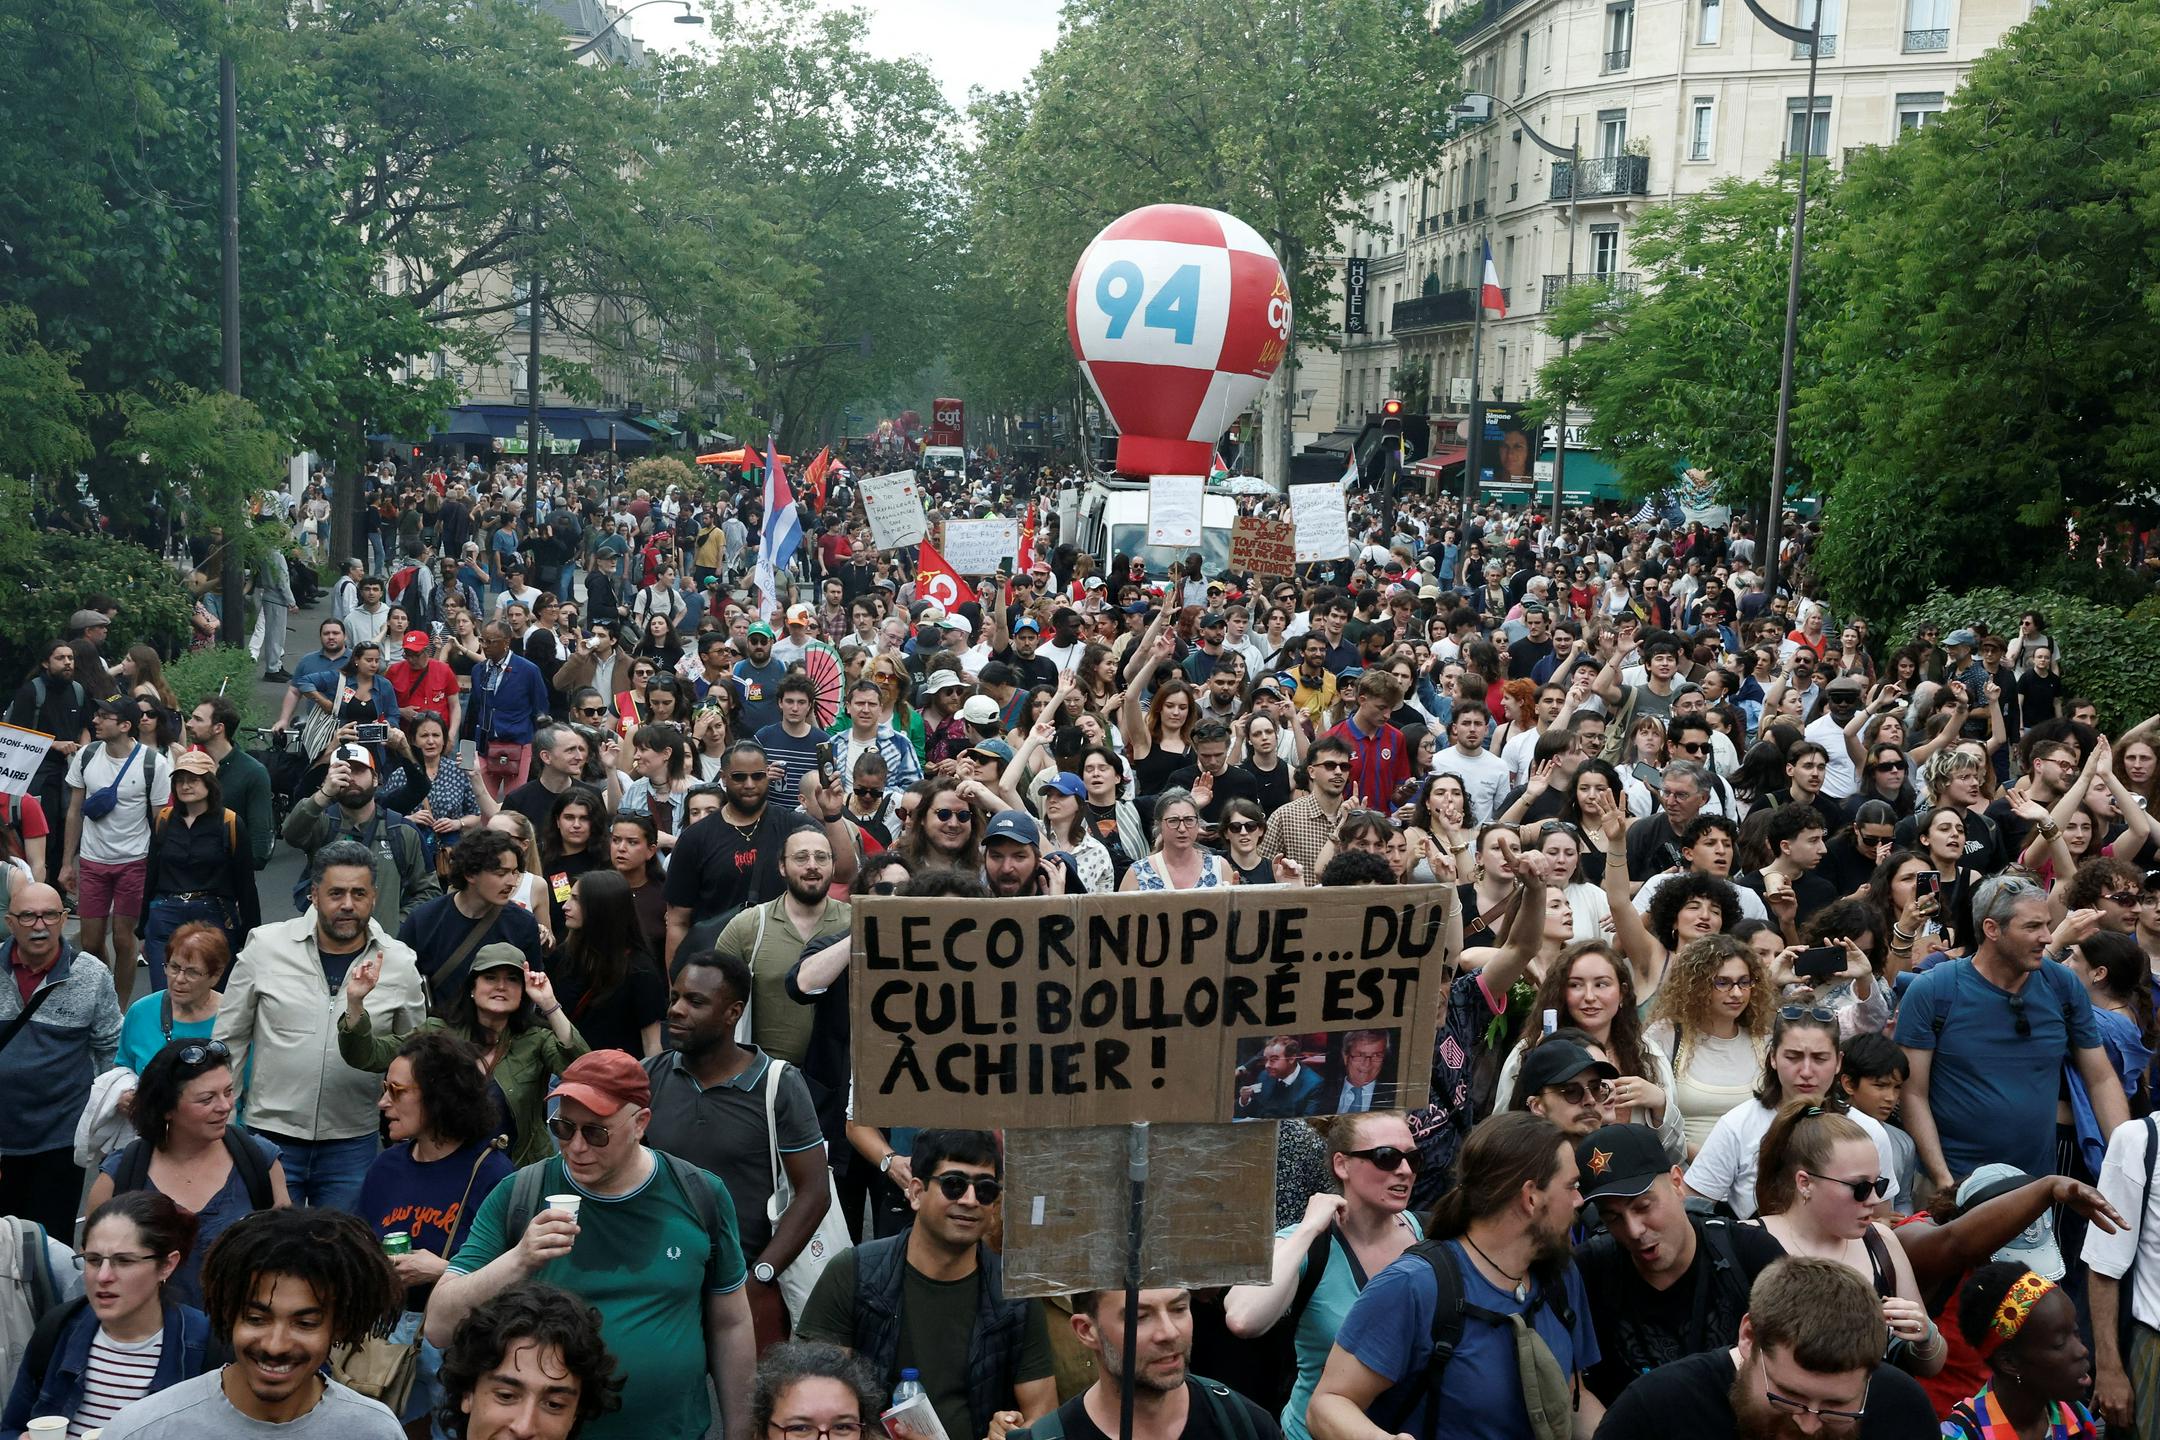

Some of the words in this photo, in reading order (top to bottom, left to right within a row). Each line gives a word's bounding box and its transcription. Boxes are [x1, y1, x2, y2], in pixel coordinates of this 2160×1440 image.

[1096, 260, 1201, 345] 94
[1350, 265, 1364, 315] HOTEL
[937, 409, 961, 426] cgt
[1036, 961, 1298, 1034] BOLLORÉ
[1321, 967, 1420, 1021] EST
[381, 1204, 413, 1228] new
